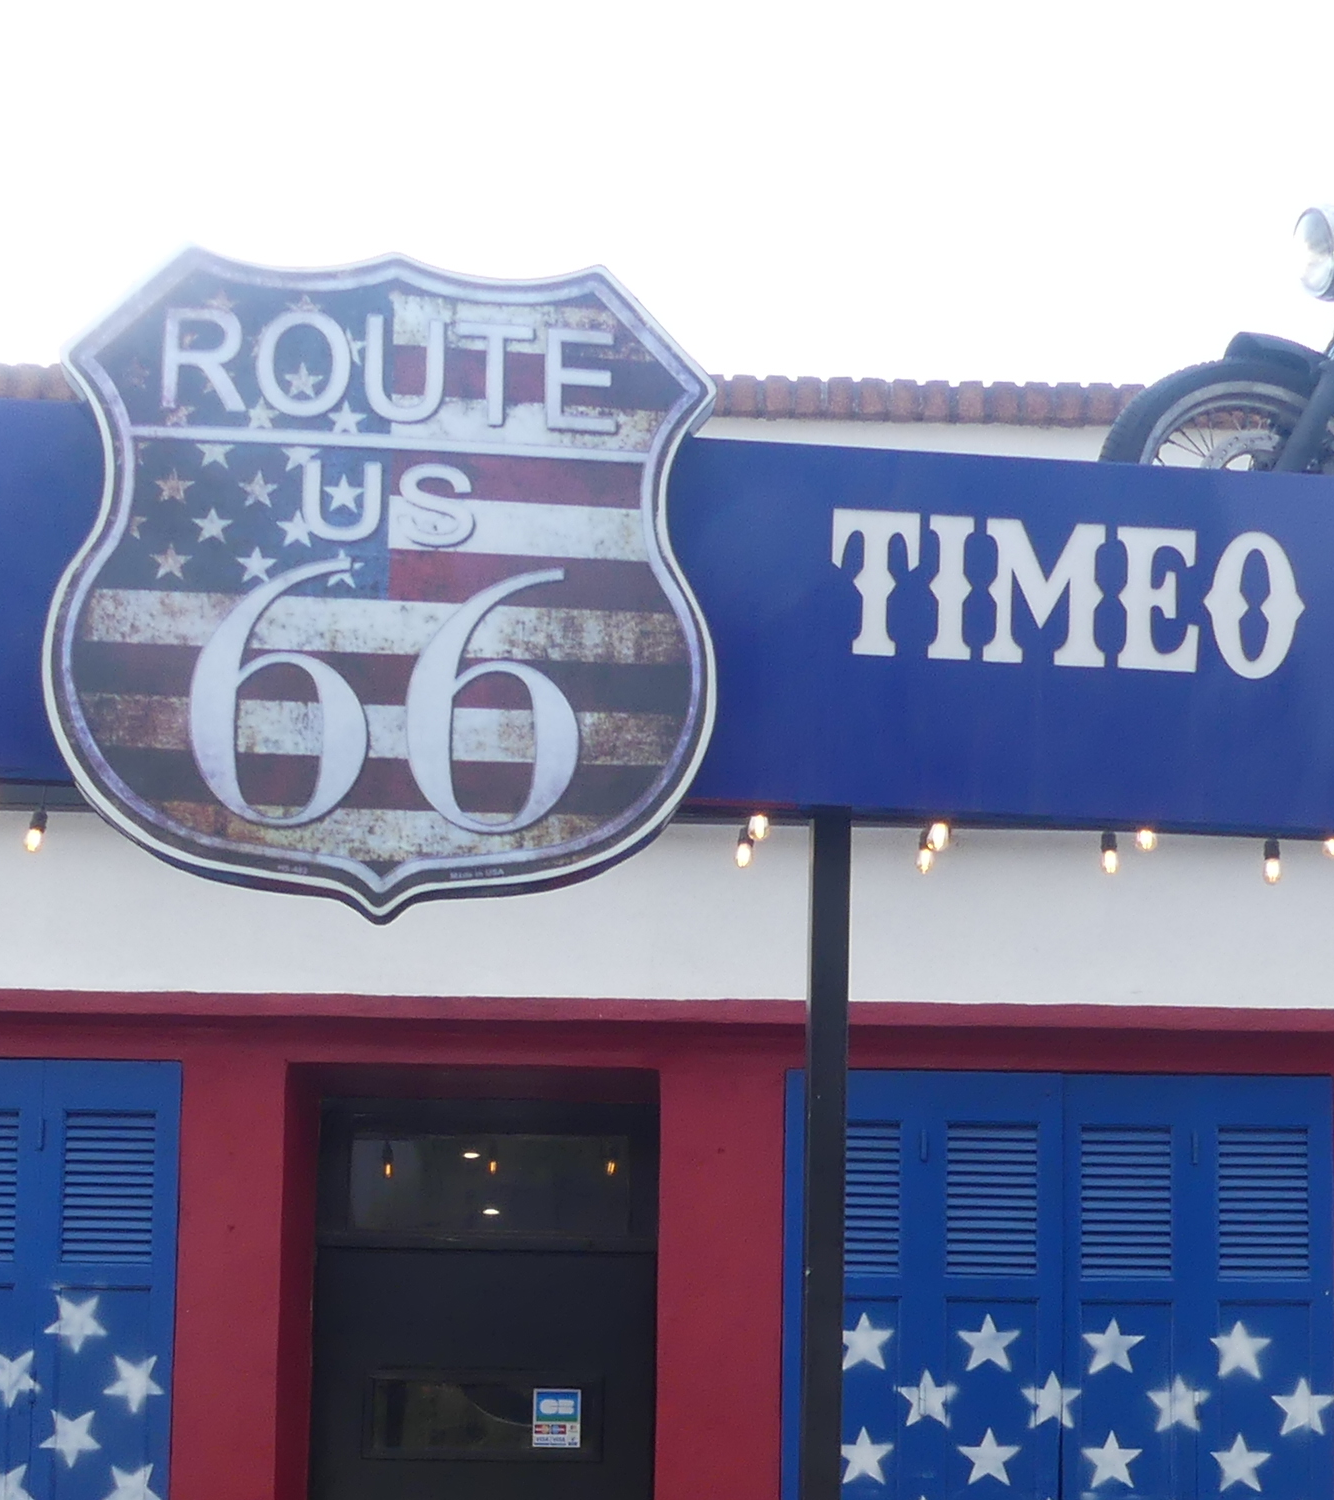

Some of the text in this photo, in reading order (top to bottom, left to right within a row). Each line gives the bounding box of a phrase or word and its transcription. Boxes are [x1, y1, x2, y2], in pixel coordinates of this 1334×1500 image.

[161, 306, 619, 434] ROUTE
[301, 458, 476, 549] US
[831, 507, 1306, 680] TIMEO
[188, 556, 581, 834] 66
[485, 868, 505, 878] USA
